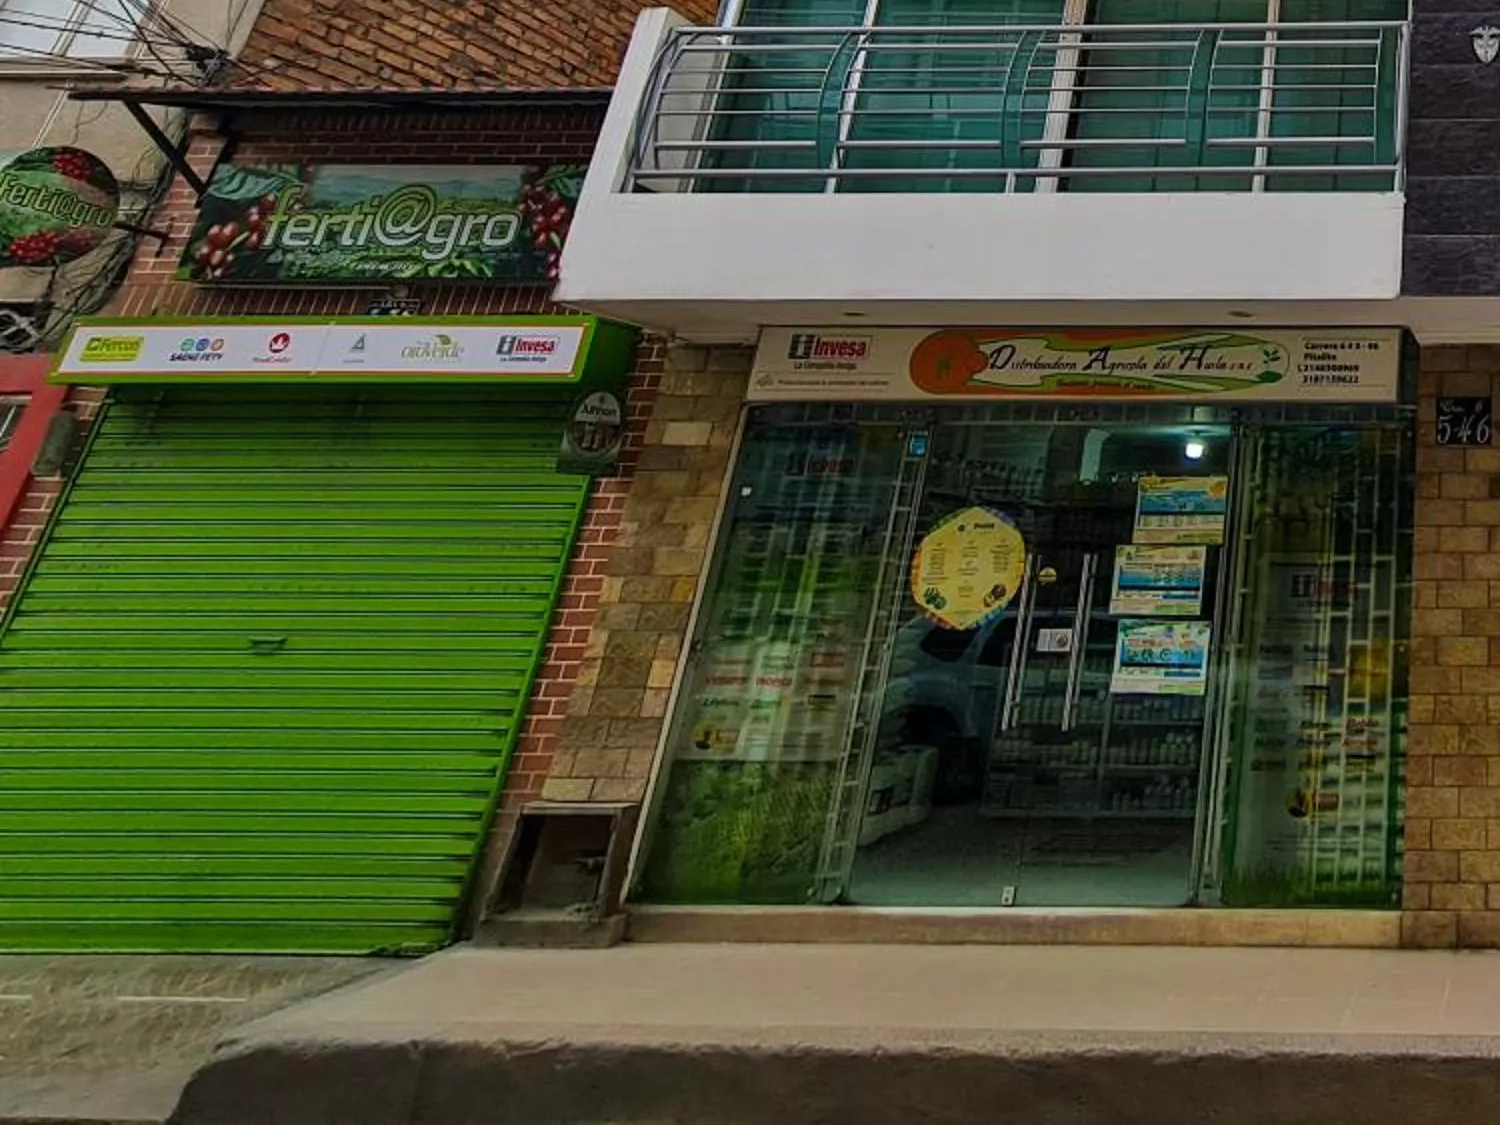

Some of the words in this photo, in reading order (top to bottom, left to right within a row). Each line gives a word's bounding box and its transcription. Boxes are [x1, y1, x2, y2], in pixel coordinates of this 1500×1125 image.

[260, 183, 522, 261] ferti@gro
[516, 338, 556, 352] Invesa
[813, 336, 867, 357] Invesa
[1153, 355, 1173, 371] del
